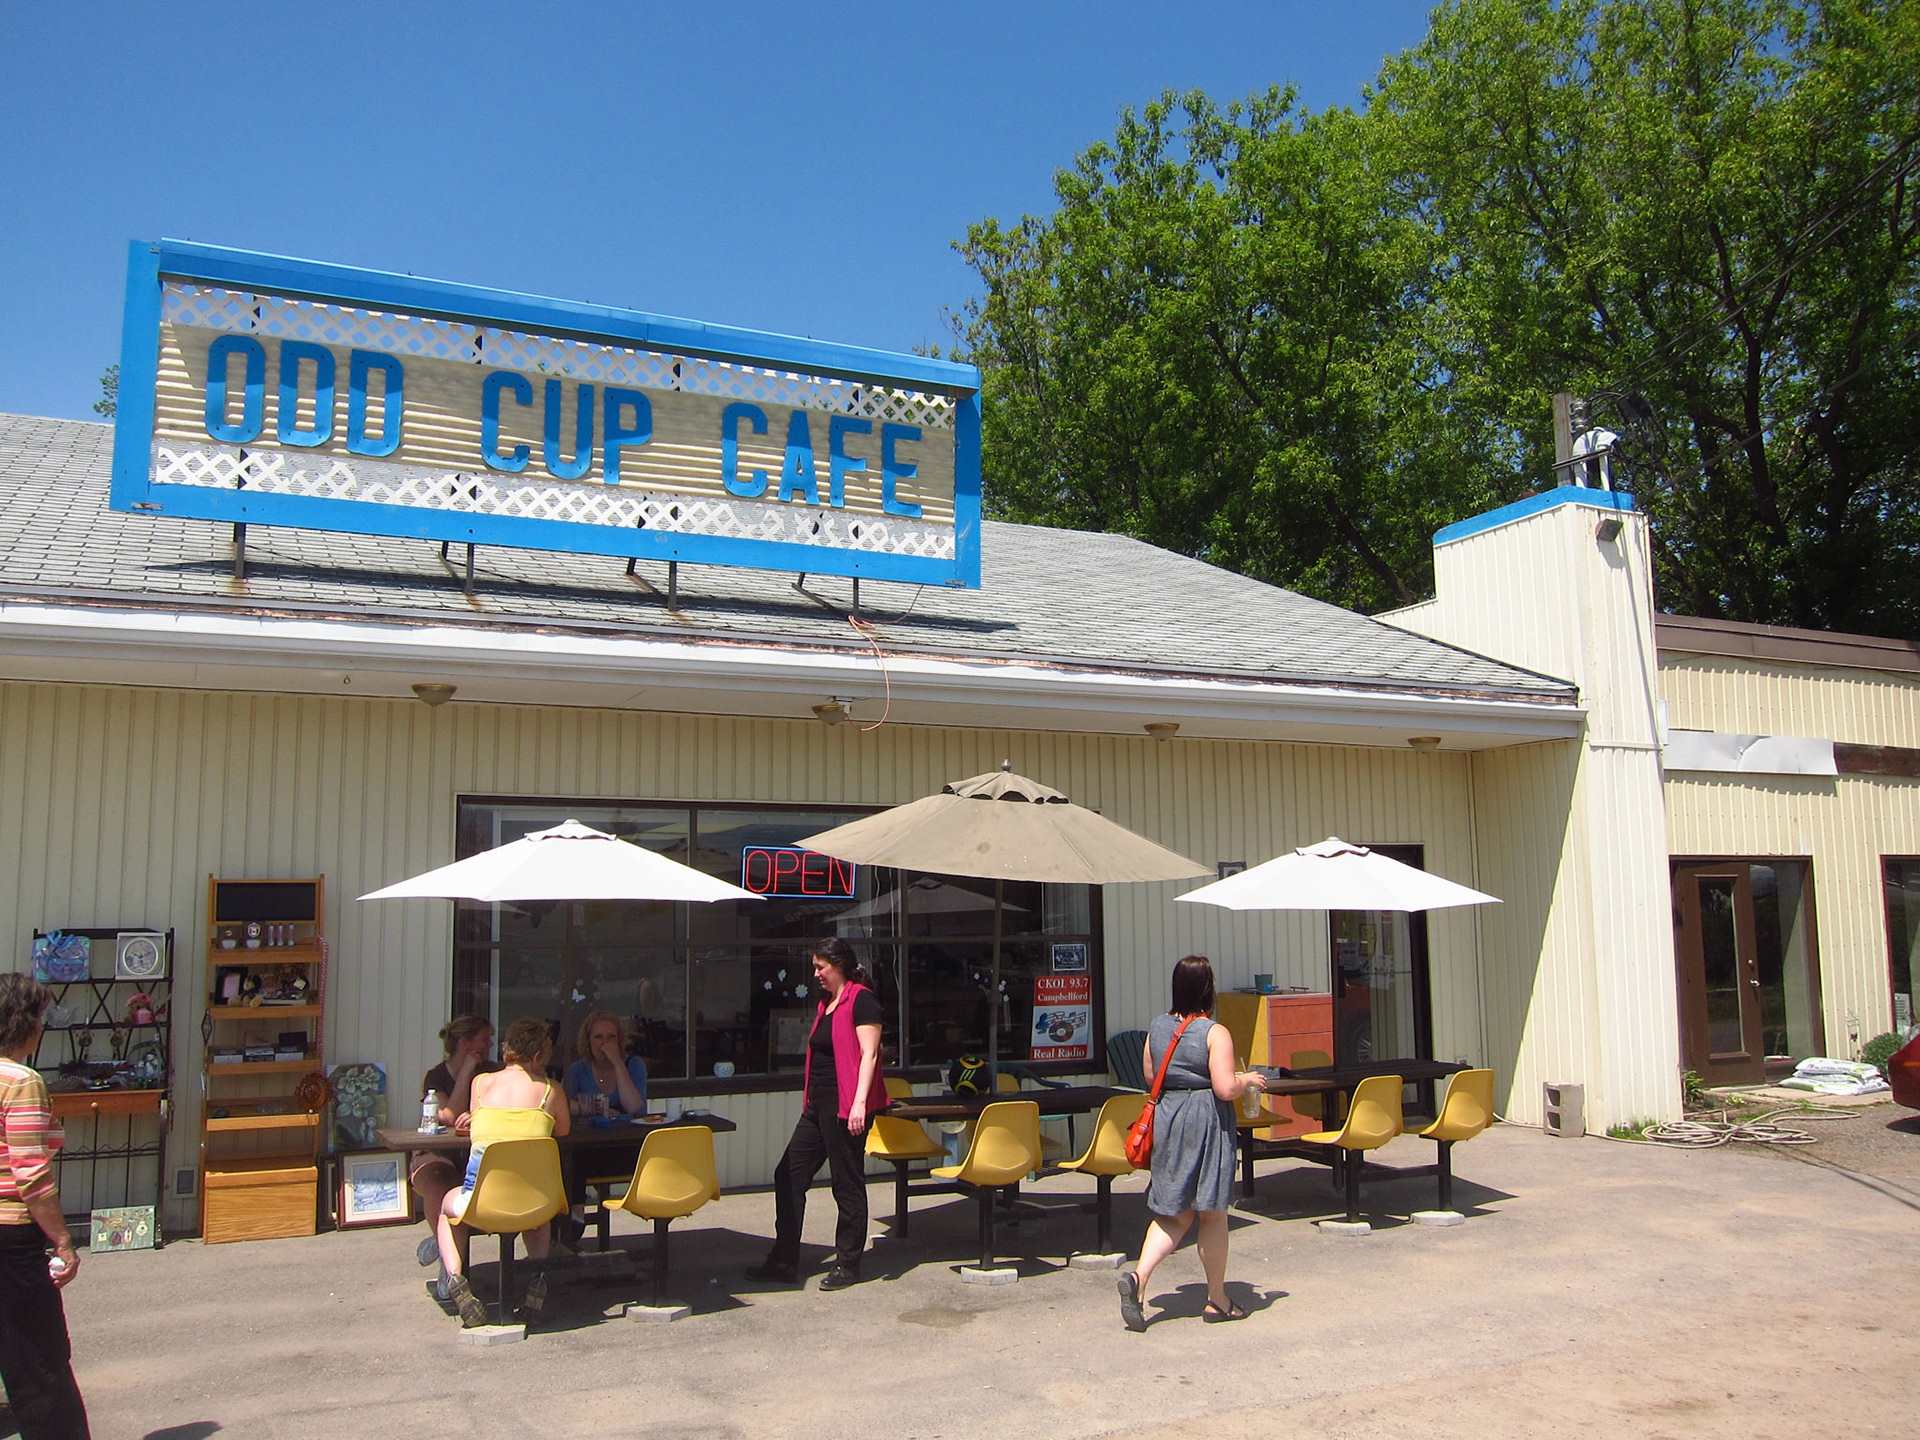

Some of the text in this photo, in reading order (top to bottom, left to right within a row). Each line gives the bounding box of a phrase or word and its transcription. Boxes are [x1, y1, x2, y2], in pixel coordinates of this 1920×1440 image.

[205, 335, 922, 519] ODD CUP CAFE
[746, 850, 853, 893] OPEN
[1037, 977, 1088, 989] CKOL 93.7
[1037, 992, 1088, 1003] Campbellford
[1033, 1047, 1085, 1059] Real Radio
